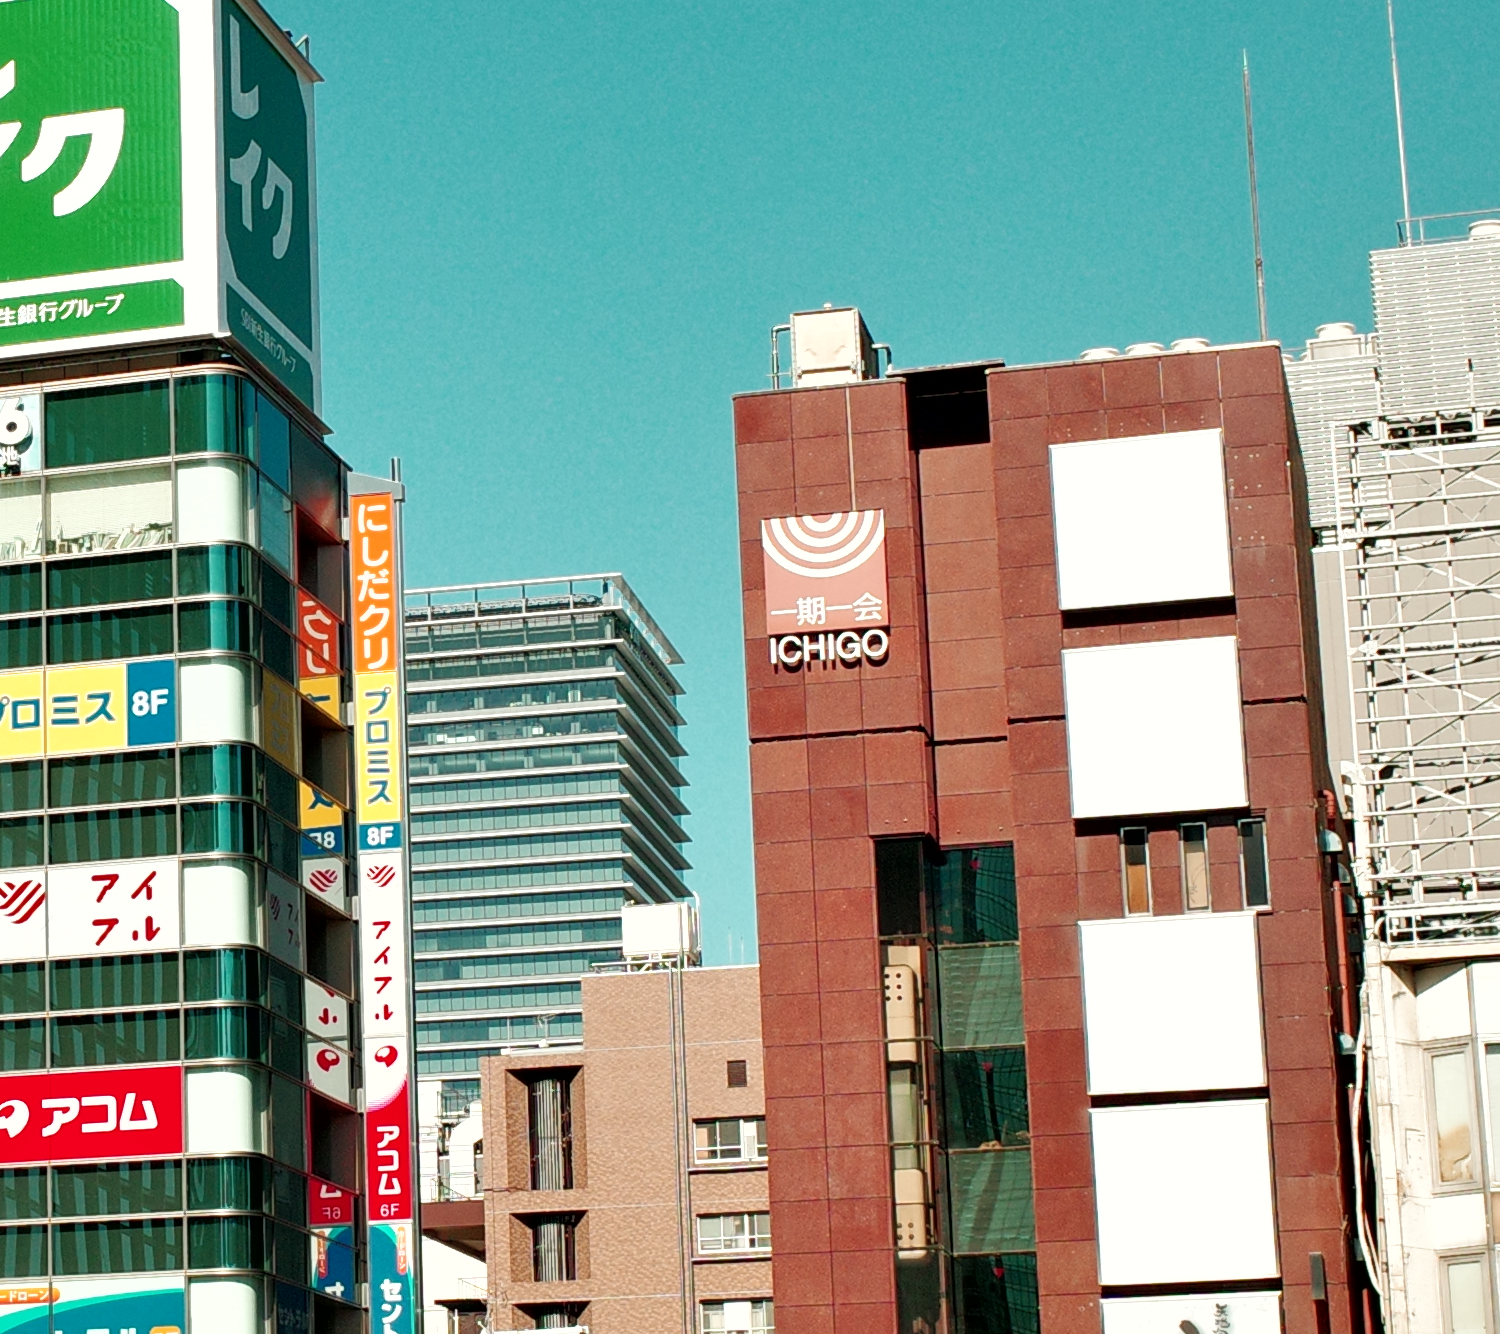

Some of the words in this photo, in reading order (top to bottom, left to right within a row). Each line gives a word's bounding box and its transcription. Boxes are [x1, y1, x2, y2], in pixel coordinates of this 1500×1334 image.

[357, 503, 390, 670] にしだクリ
[771, 592, 882, 625] 一期一会
[769, 629, 889, 664] ICHIGO
[132, 688, 168, 716] 8F
[365, 686, 393, 805] プロミス
[367, 826, 394, 846] 8F
[372, 920, 393, 1021] アイフル
[42, 1093, 158, 1137] アコム
[377, 1125, 401, 1195] アコム
[380, 1203, 400, 1218] 6F
